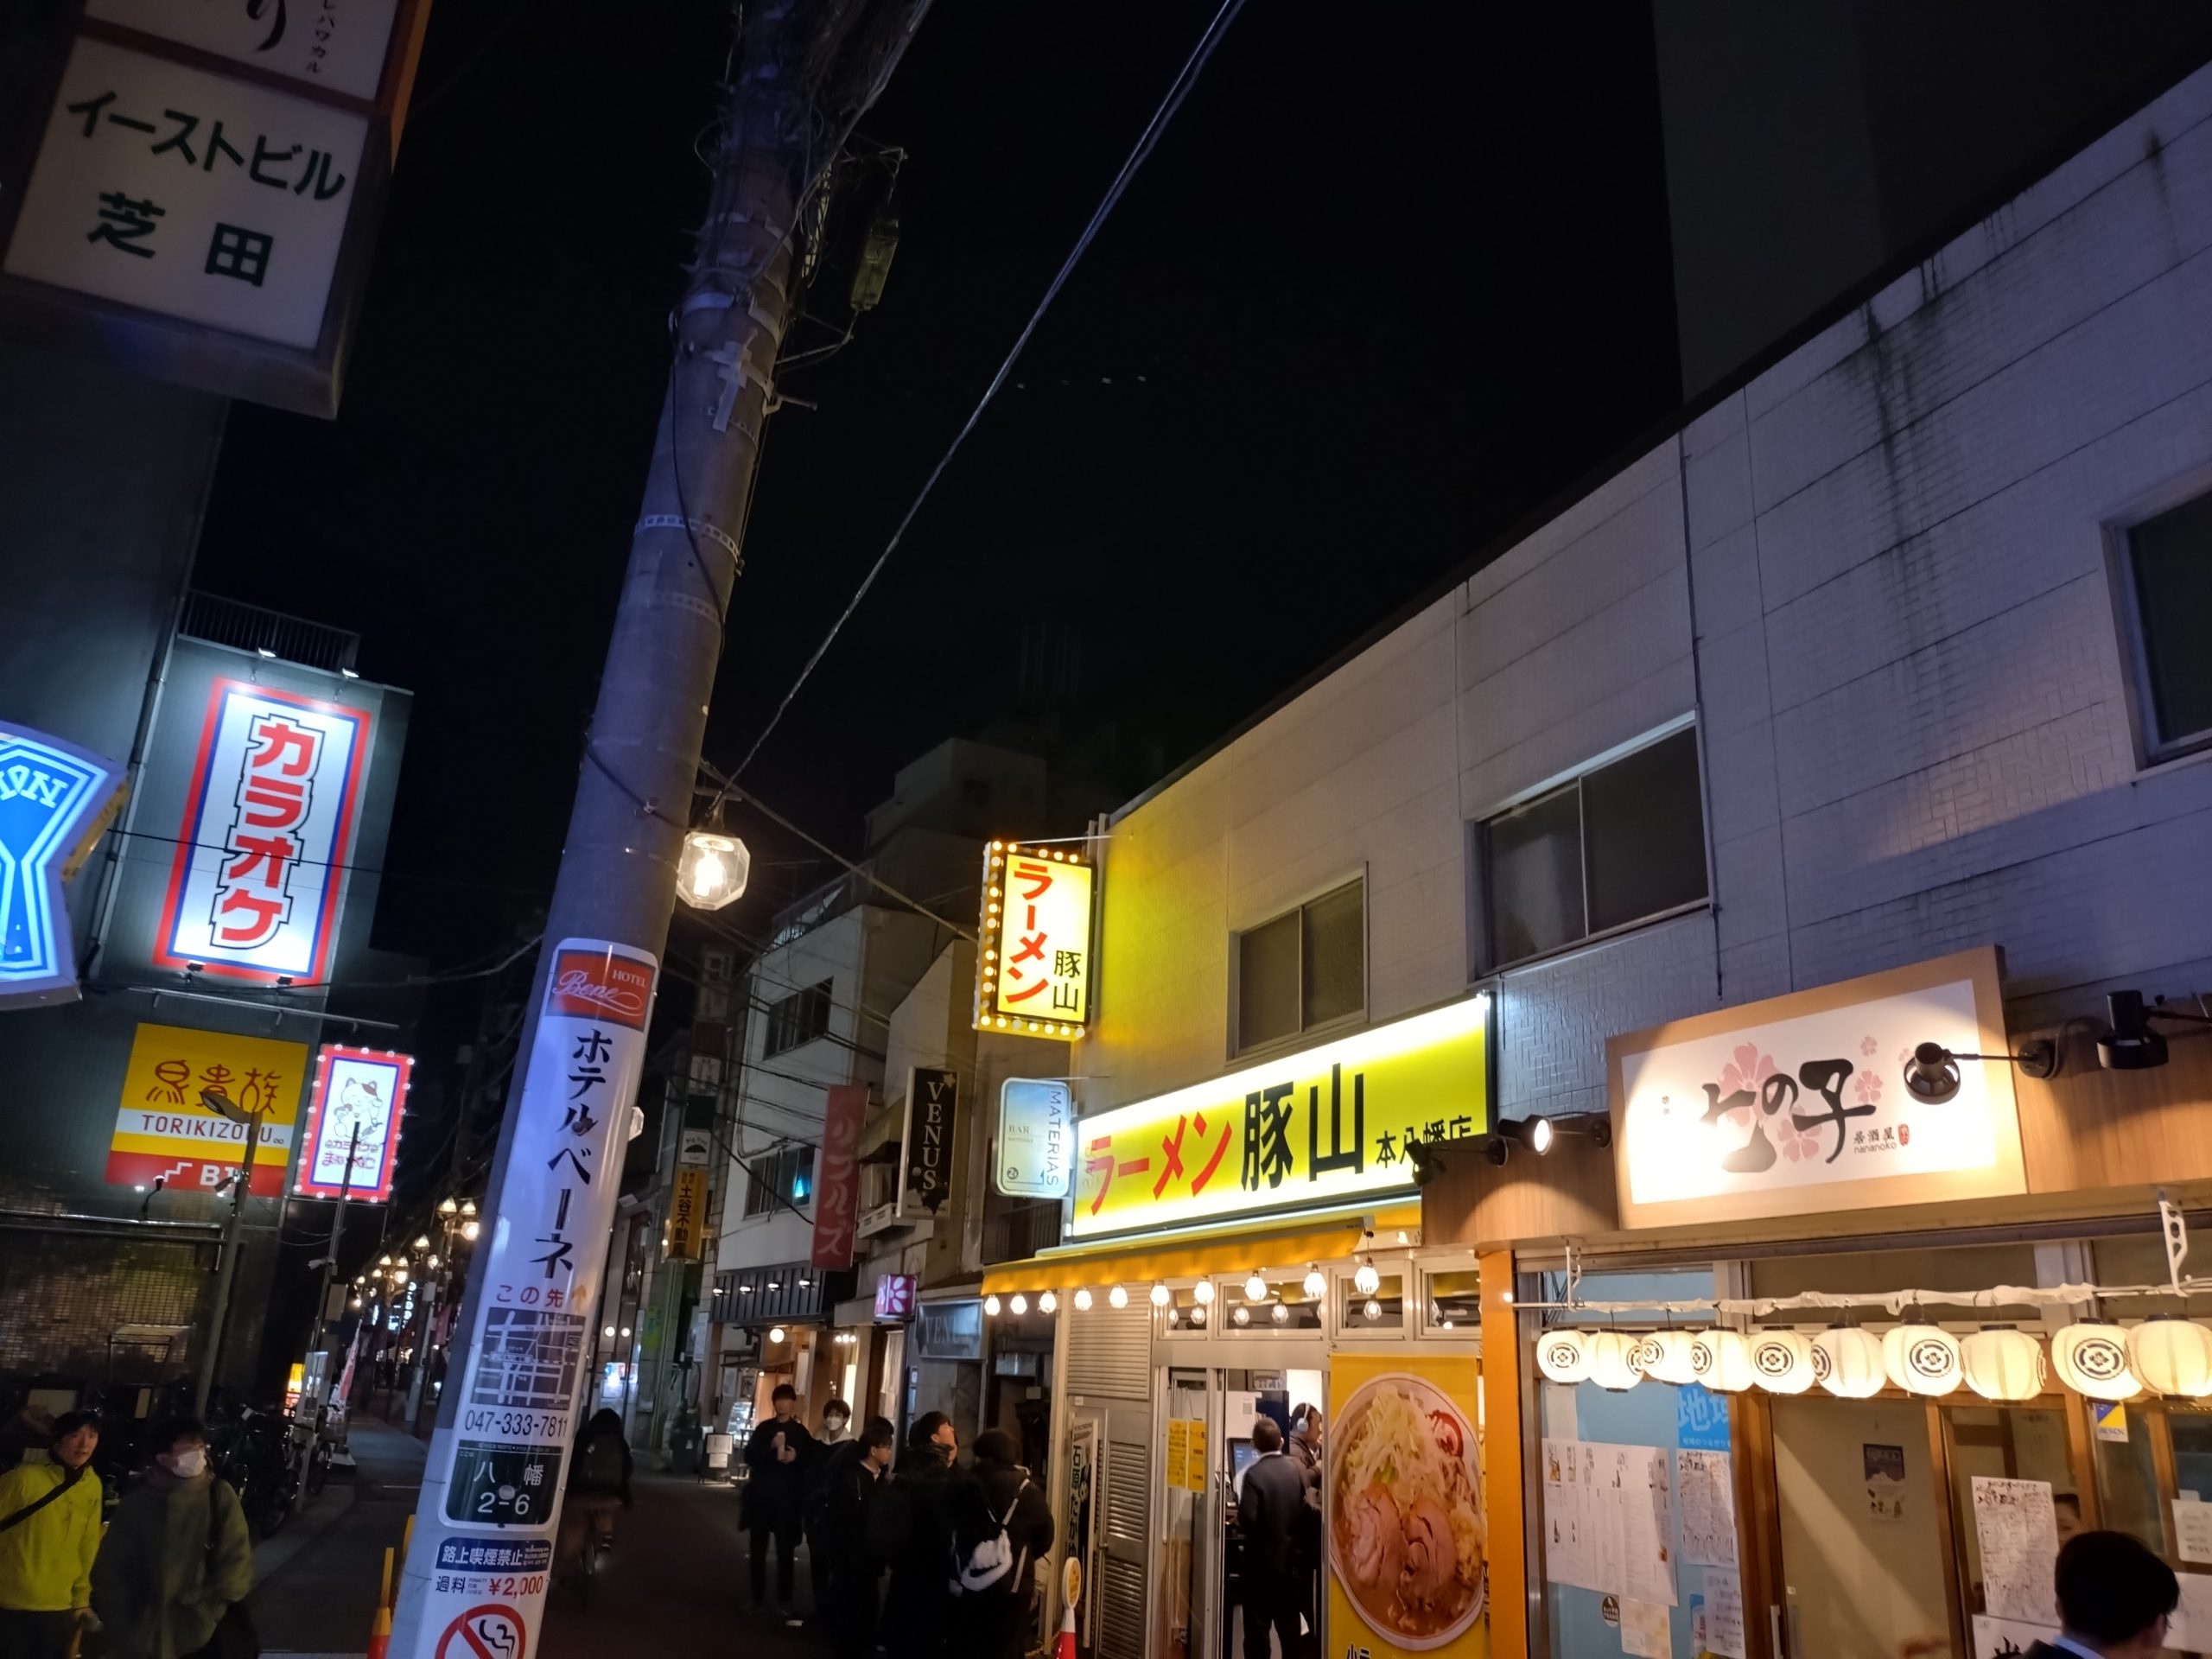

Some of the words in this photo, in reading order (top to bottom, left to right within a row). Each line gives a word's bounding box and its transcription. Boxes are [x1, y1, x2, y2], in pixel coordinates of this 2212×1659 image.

[67, 91, 345, 200] イーストビル
[88, 192, 274, 288] 芝田
[216, 719, 319, 944] カラオケ
[1006, 862, 1052, 1004] ラーメン
[612, 969, 646, 988] HOTEL
[1052, 950, 1082, 1013] 豚山
[142, 1115, 273, 1142] TORIKIZOU
[922, 1081, 945, 1190] VENUS
[1008, 1125, 1030, 1135] BAR
[1046, 1090, 1062, 1186] MATERIAS
[1090, 1112, 1232, 1216] ラーメン
[1242, 1063, 1364, 1192] 豚山
[530, 1029, 613, 1279] ホテルベーネ
[1853, 1141, 1897, 1154] nananoko
[497, 1285, 564, 1308] この先
[465, 1409, 568, 1437] 047-333-7811
[474, 1462, 543, 1486] 八幡
[477, 1492, 531, 1515] 2-6
[442, 1545, 523, 1567] 路上喫煙禁止
[435, 1576, 466, 1594] 過料
[489, 1576, 543, 1599] ¥2,000
